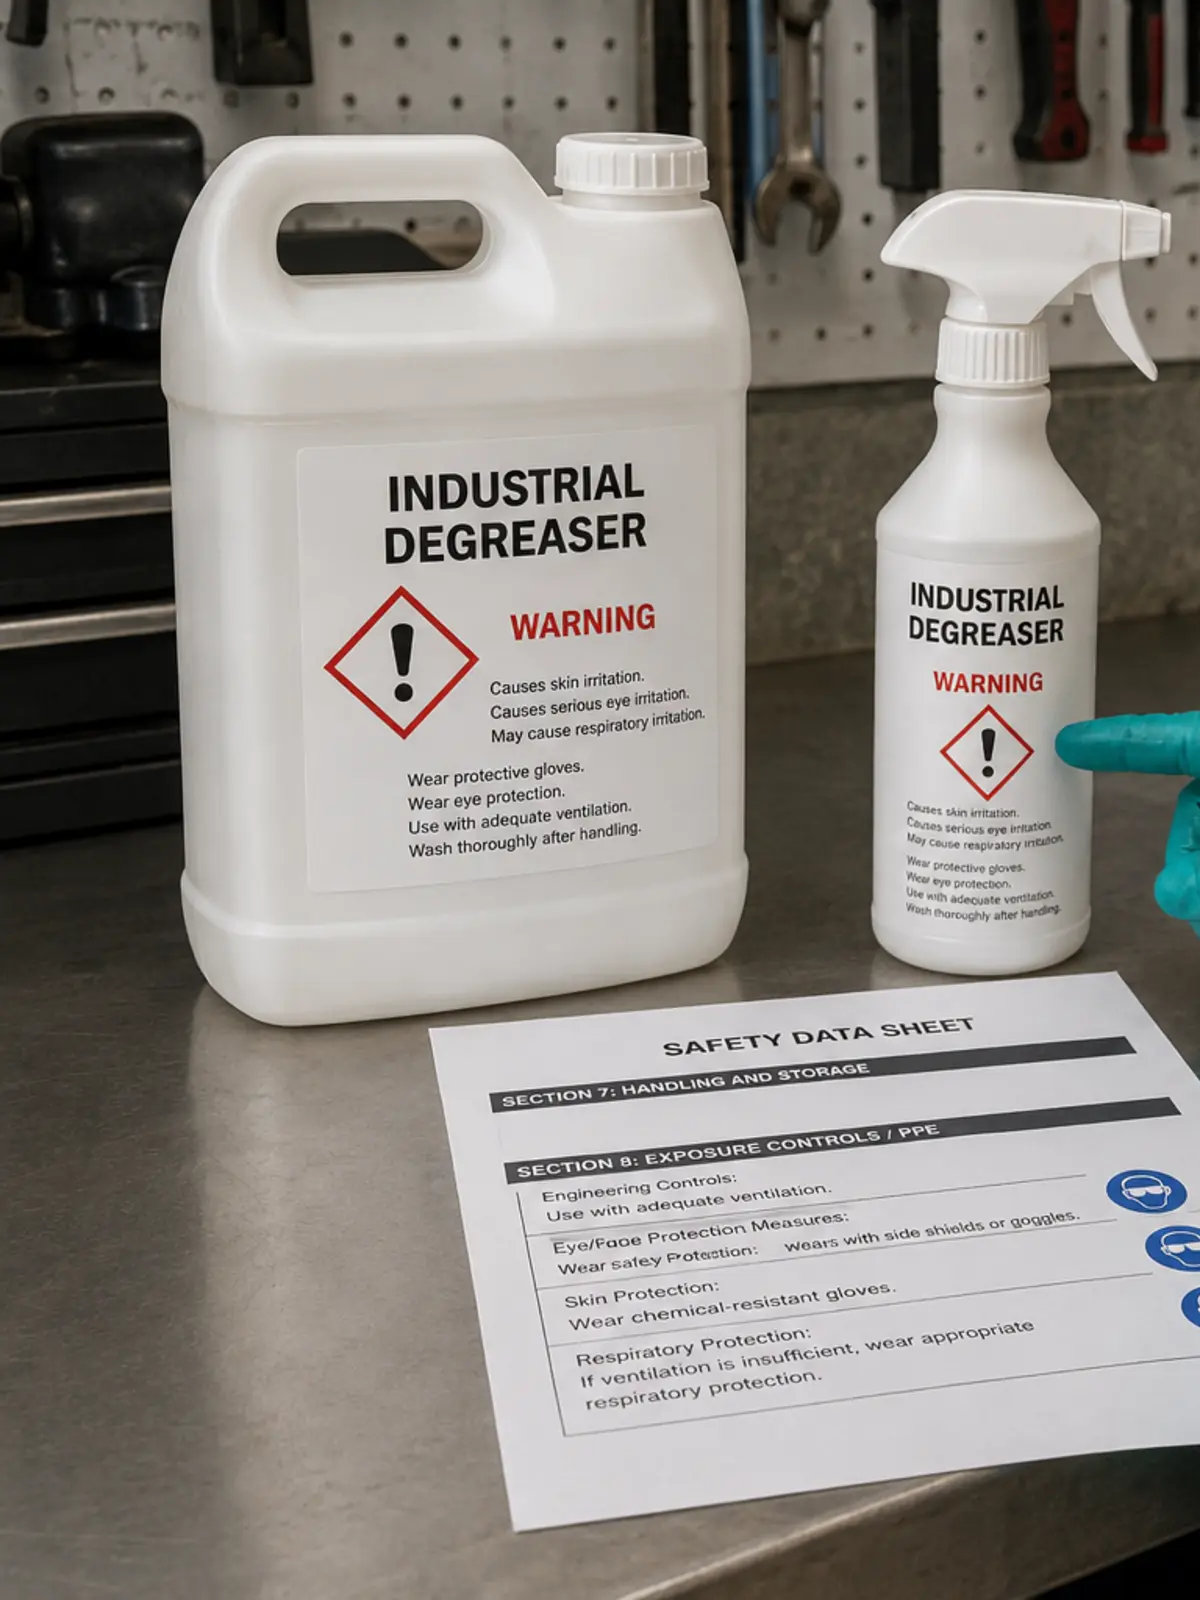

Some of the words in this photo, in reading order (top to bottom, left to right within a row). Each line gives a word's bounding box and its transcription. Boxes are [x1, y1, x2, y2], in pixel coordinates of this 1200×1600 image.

[388, 462, 645, 512] INDUSTRIAL
[383, 512, 647, 565] DEGREASER
[910, 581, 1065, 612] INDUSTRIAL
[509, 602, 656, 640] WARNING
[909, 614, 1064, 646] DEGREASER
[490, 679, 546, 696] Causes
[550, 676, 579, 692] skin
[584, 670, 644, 688] irritation.
[932, 670, 1044, 694] WARNING
[490, 703, 546, 720] Causes
[550, 697, 602, 715] serious
[606, 695, 631, 710] eye
[634, 687, 690, 705] irritation.
[491, 729, 523, 744] May
[527, 724, 571, 740] cause
[575, 716, 649, 736] respiratory
[652, 708, 705, 726] irritation.
[407, 770, 450, 787] Wear
[453, 764, 530, 785] protective
[533, 758, 584, 779] gloves.
[407, 794, 451, 811] Wear
[454, 791, 482, 808] eye
[486, 784, 566, 806] protection.
[907, 800, 943, 816] Causes
[946, 807, 967, 818] skin
[970, 807, 1020, 819] irritation.
[407, 818, 440, 835] Use
[443, 814, 476, 832] with
[480, 807, 551, 829] adequate
[555, 799, 632, 820] ventilation.
[945, 823, 984, 835] serious
[408, 841, 453, 858] Wash
[457, 833, 538, 855] thoroughly
[542, 828, 575, 846] after
[578, 820, 641, 841] handling.
[906, 855, 930, 868] Wear
[933, 860, 986, 873] protective
[989, 863, 1025, 876] gloves.
[954, 879, 1011, 890] protection.
[994, 910, 1018, 921] after
[662, 1033, 782, 1058] SAFETY
[790, 1025, 874, 1046] DATA
[880, 1016, 975, 1037] SHEET
[501, 1087, 593, 1108] SECTION
[597, 1085, 616, 1099] 7:
[620, 1075, 726, 1096] HANDLING
[731, 1072, 773, 1087] AND
[778, 1063, 871, 1081] STORAGE
[517, 1157, 613, 1178] SECTION
[619, 1155, 640, 1169] 8:
[644, 1142, 762, 1165] EXPOSURE
[766, 1129, 880, 1153] CONTROLS
[897, 1123, 940, 1138] PPE
[541, 1177, 652, 1204] Engineering
[655, 1172, 738, 1191] Controls:
[546, 1207, 584, 1222] Use
[589, 1203, 631, 1218] with
[636, 1194, 726, 1216] adequate
[730, 1183, 832, 1204] ventilation.
[552, 1234, 642, 1256] Eye/Face
[648, 1224, 746, 1244] Protection
[750, 1213, 849, 1232] Measures:
[844, 1232, 880, 1246] with
[884, 1228, 921, 1242] side
[925, 1220, 985, 1237] shields
[989, 1219, 1006, 1229] or
[1010, 1210, 1080, 1229] goggles.
[558, 1260, 606, 1276] Wear
[563, 1293, 608, 1310] Skin
[613, 1280, 720, 1303] Protection:
[569, 1313, 625, 1332] Wear
[631, 1290, 820, 1323] chemical-resistant
[825, 1281, 897, 1302] gloves.
[576, 1341, 694, 1367] Respiratory
[700, 1327, 811, 1351] Protection:
[580, 1373, 595, 1388] If
[600, 1361, 711, 1387] ventilation
[717, 1358, 736, 1372] is
[740, 1342, 861, 1369] insufficient,
[864, 1335, 915, 1353] wear
[920, 1319, 1034, 1346] appropriate
[585, 1385, 702, 1411] respiratory
[708, 1370, 822, 1397] protection.
